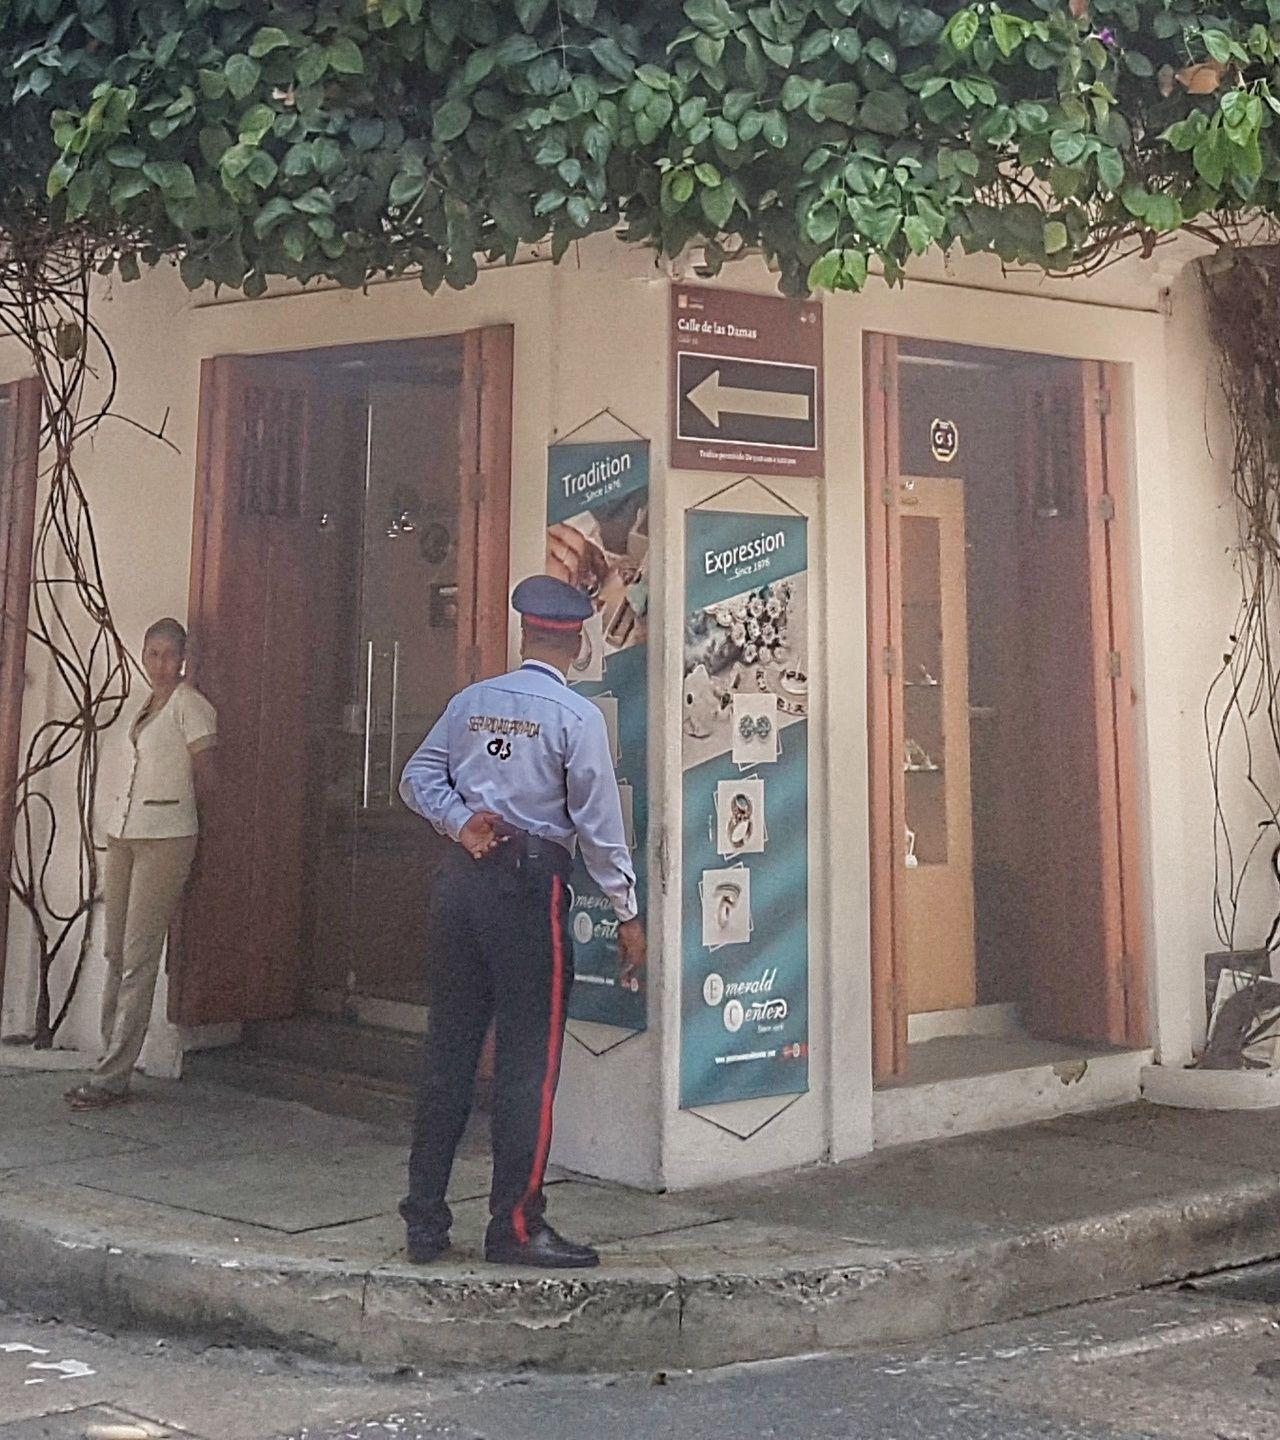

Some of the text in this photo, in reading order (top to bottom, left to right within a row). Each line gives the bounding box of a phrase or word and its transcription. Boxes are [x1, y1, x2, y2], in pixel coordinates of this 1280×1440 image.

[677, 318, 758, 339] Calle de las Damas
[562, 453, 631, 498] Tradition
[705, 531, 785, 575] Expression
[703, 968, 777, 1006] Emerald
[724, 998, 787, 1032] Center
